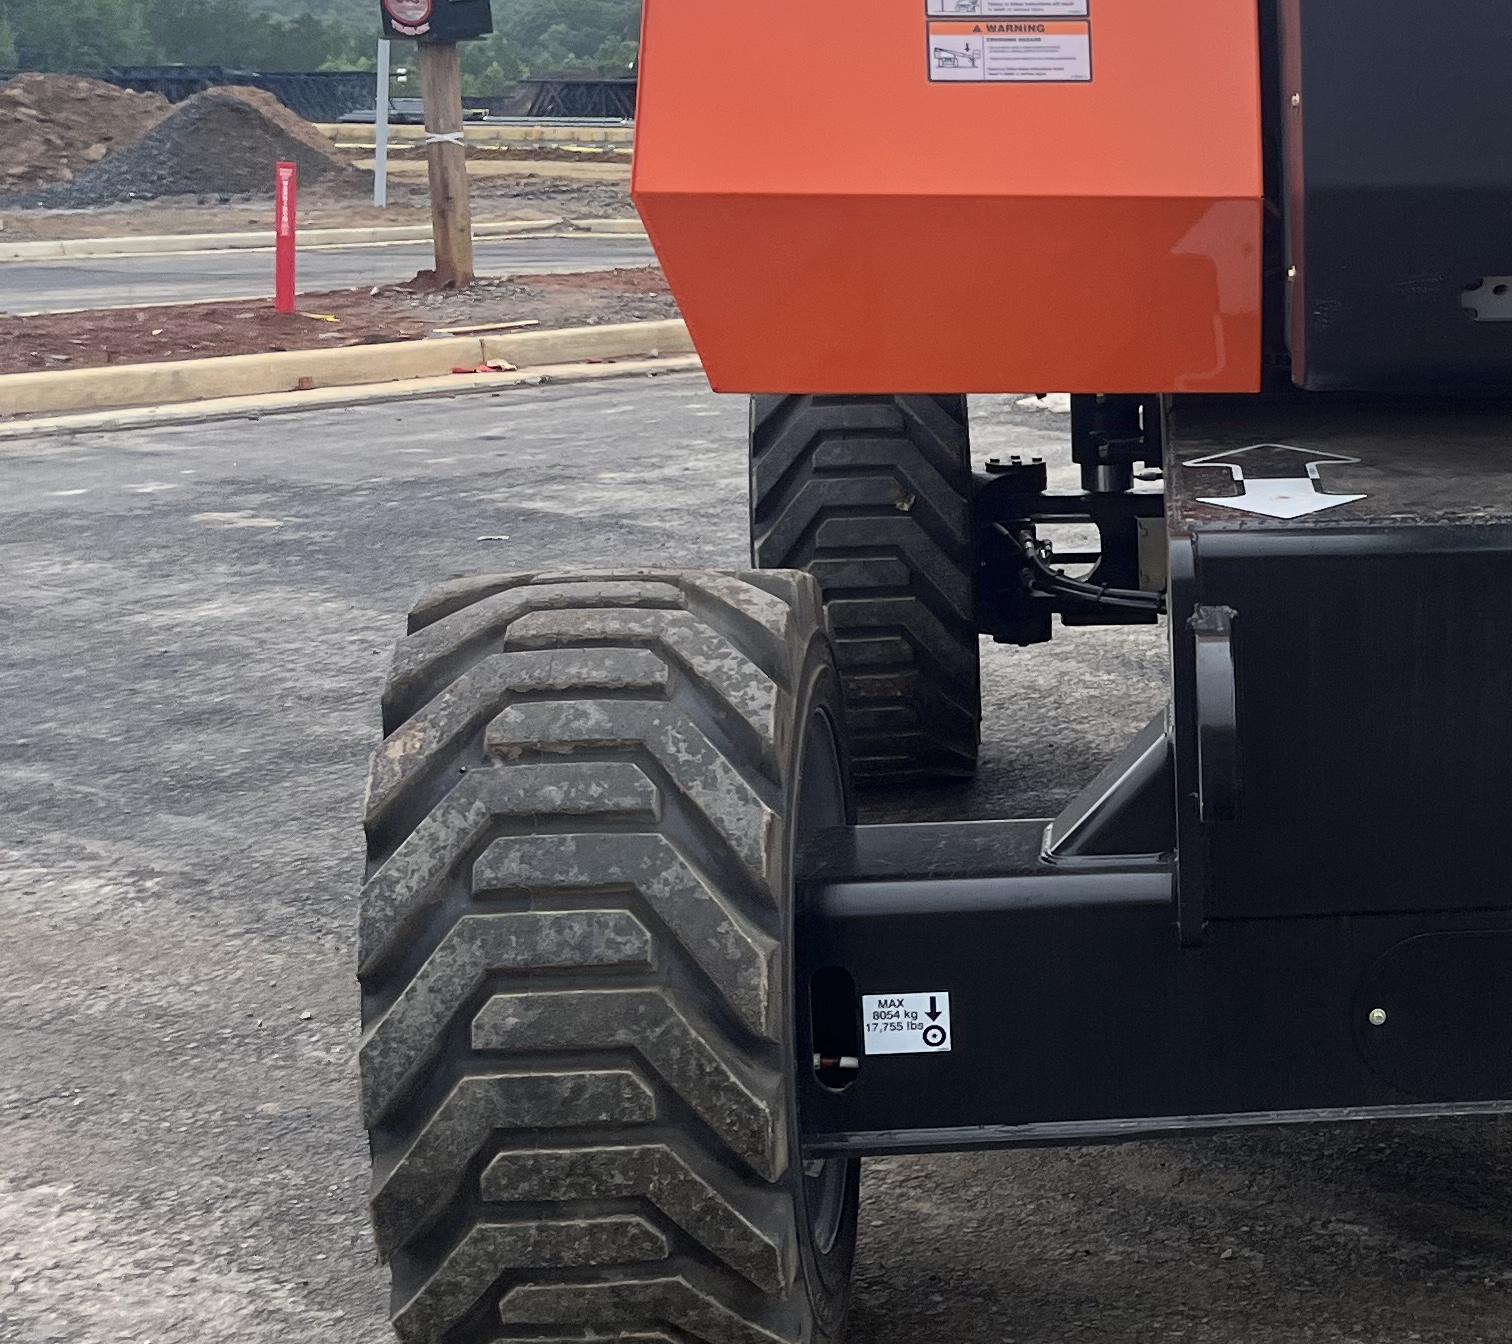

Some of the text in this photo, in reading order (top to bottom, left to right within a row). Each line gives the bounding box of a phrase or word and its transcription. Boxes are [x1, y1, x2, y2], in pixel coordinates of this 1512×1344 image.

[986, 24, 1046, 33] WARNING
[877, 998, 905, 1009] MAX
[872, 1010, 918, 1021] 8054 kg
[866, 1021, 924, 1033] 17,755 lbs
